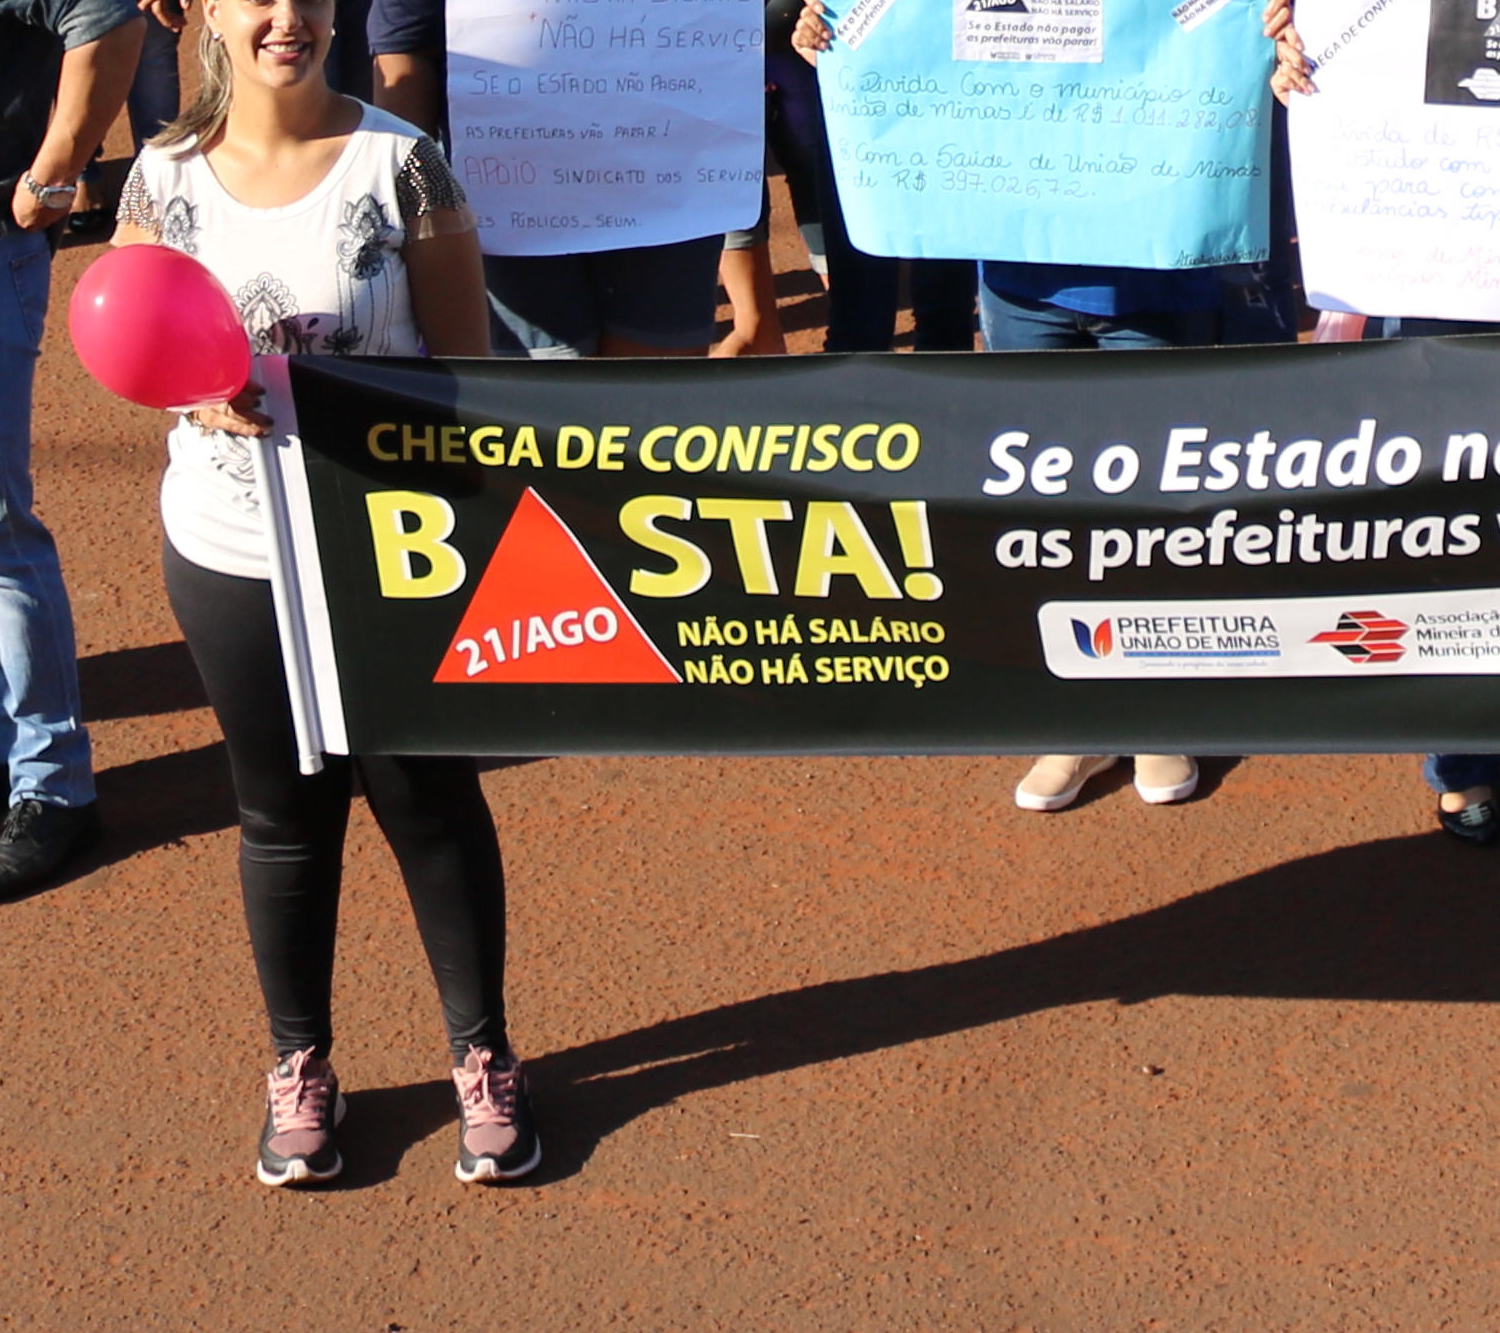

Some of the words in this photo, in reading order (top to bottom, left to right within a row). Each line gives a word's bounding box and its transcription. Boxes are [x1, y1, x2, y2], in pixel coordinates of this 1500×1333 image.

[539, 15, 596, 50] NÃO
[609, 14, 648, 49] HÁ
[656, 27, 764, 54] SERVIÇO
[537, 71, 608, 95] ESTADO
[616, 71, 644, 93] NÃO
[465, 125, 485, 140] AS
[489, 125, 575, 141] PREFEITURAS
[580, 122, 604, 140] VÃO
[553, 169, 646, 186] SINDICATO
[656, 170, 682, 184] DOS
[366, 422, 544, 468] CHEGA
[556, 425, 631, 471] DE
[638, 422, 921, 473] CONFISCO
[981, 430, 1075, 497] Se
[1091, 443, 1141, 495] o
[1159, 418, 1423, 494] Estado
[994, 527, 1074, 569] as
[1088, 509, 1481, 582] prefeituras
[455, 606, 618, 677] 21/AGO
[677, 615, 749, 647] NÃO
[755, 613, 803, 646] HÁ
[808, 615, 946, 645] SALÁRIO
[1116, 615, 1277, 635] PREFEITURA
[1120, 634, 1183, 650] UNIÃO
[1185, 636, 1213, 650] DE
[1217, 635, 1280, 650] MINAS
[1416, 625, 1483, 642] Mineira
[684, 653, 755, 685] NÃO
[761, 652, 809, 685] HÁ
[814, 654, 950, 688] SERVIÇO
